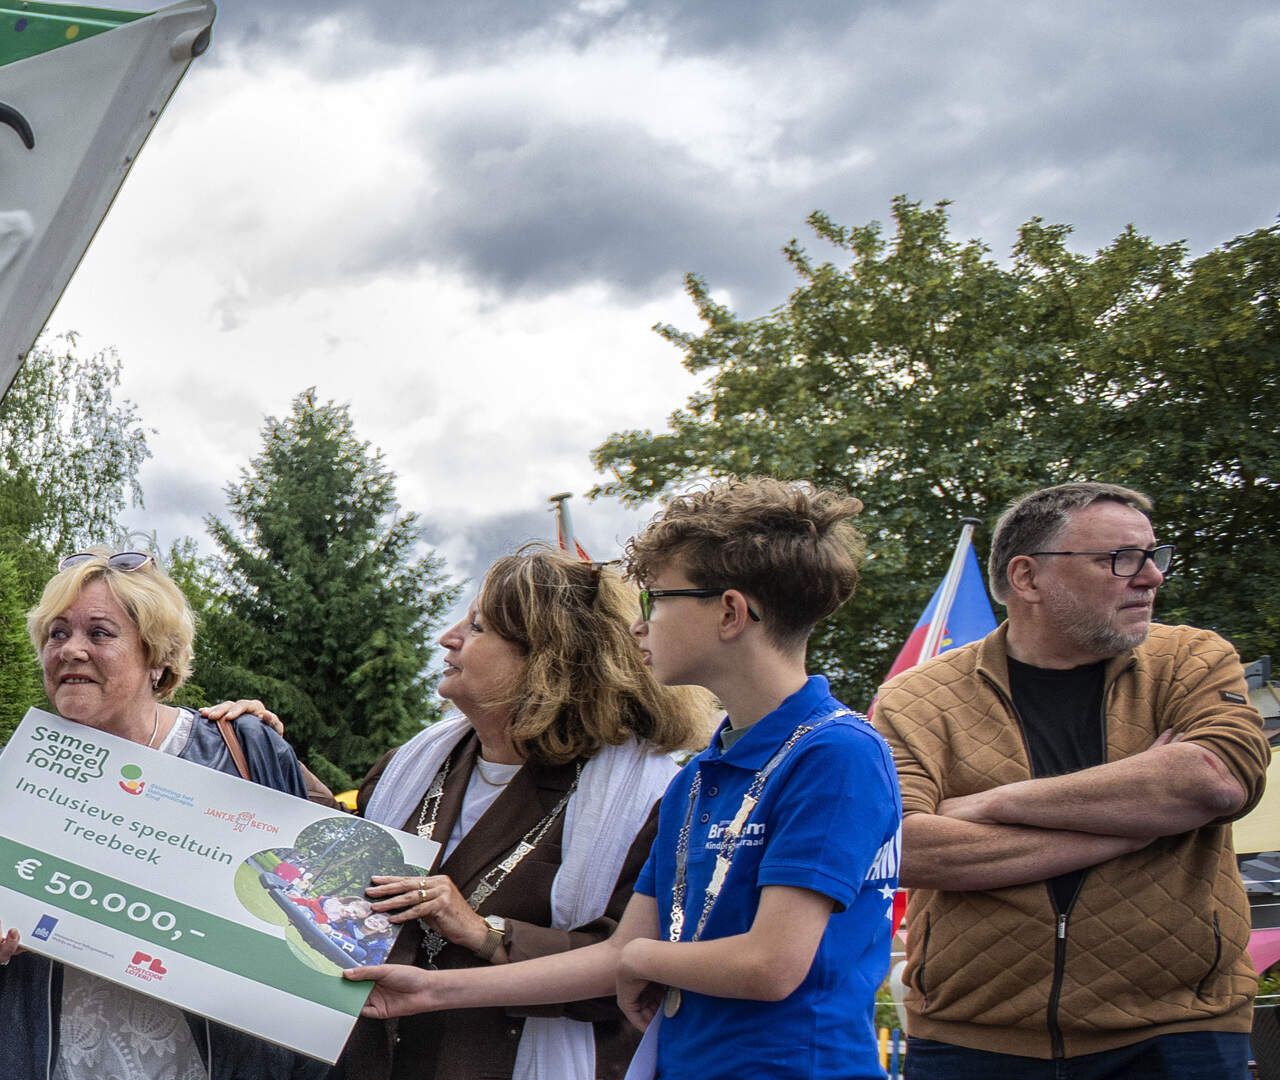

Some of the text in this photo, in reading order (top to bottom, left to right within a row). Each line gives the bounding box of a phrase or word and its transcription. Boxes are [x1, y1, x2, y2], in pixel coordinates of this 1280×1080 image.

[31, 726, 110, 758] Samen
[25, 748, 94, 783] fonds
[44, 744, 109, 774] speel
[15, 776, 233, 865] Inclusieve speeltuin
[203, 807, 279, 834] JANTJE BETON
[63, 818, 162, 865] Treebeek
[15, 858, 206, 941] € 50.000,-
[127, 963, 163, 981] POSTCODE
